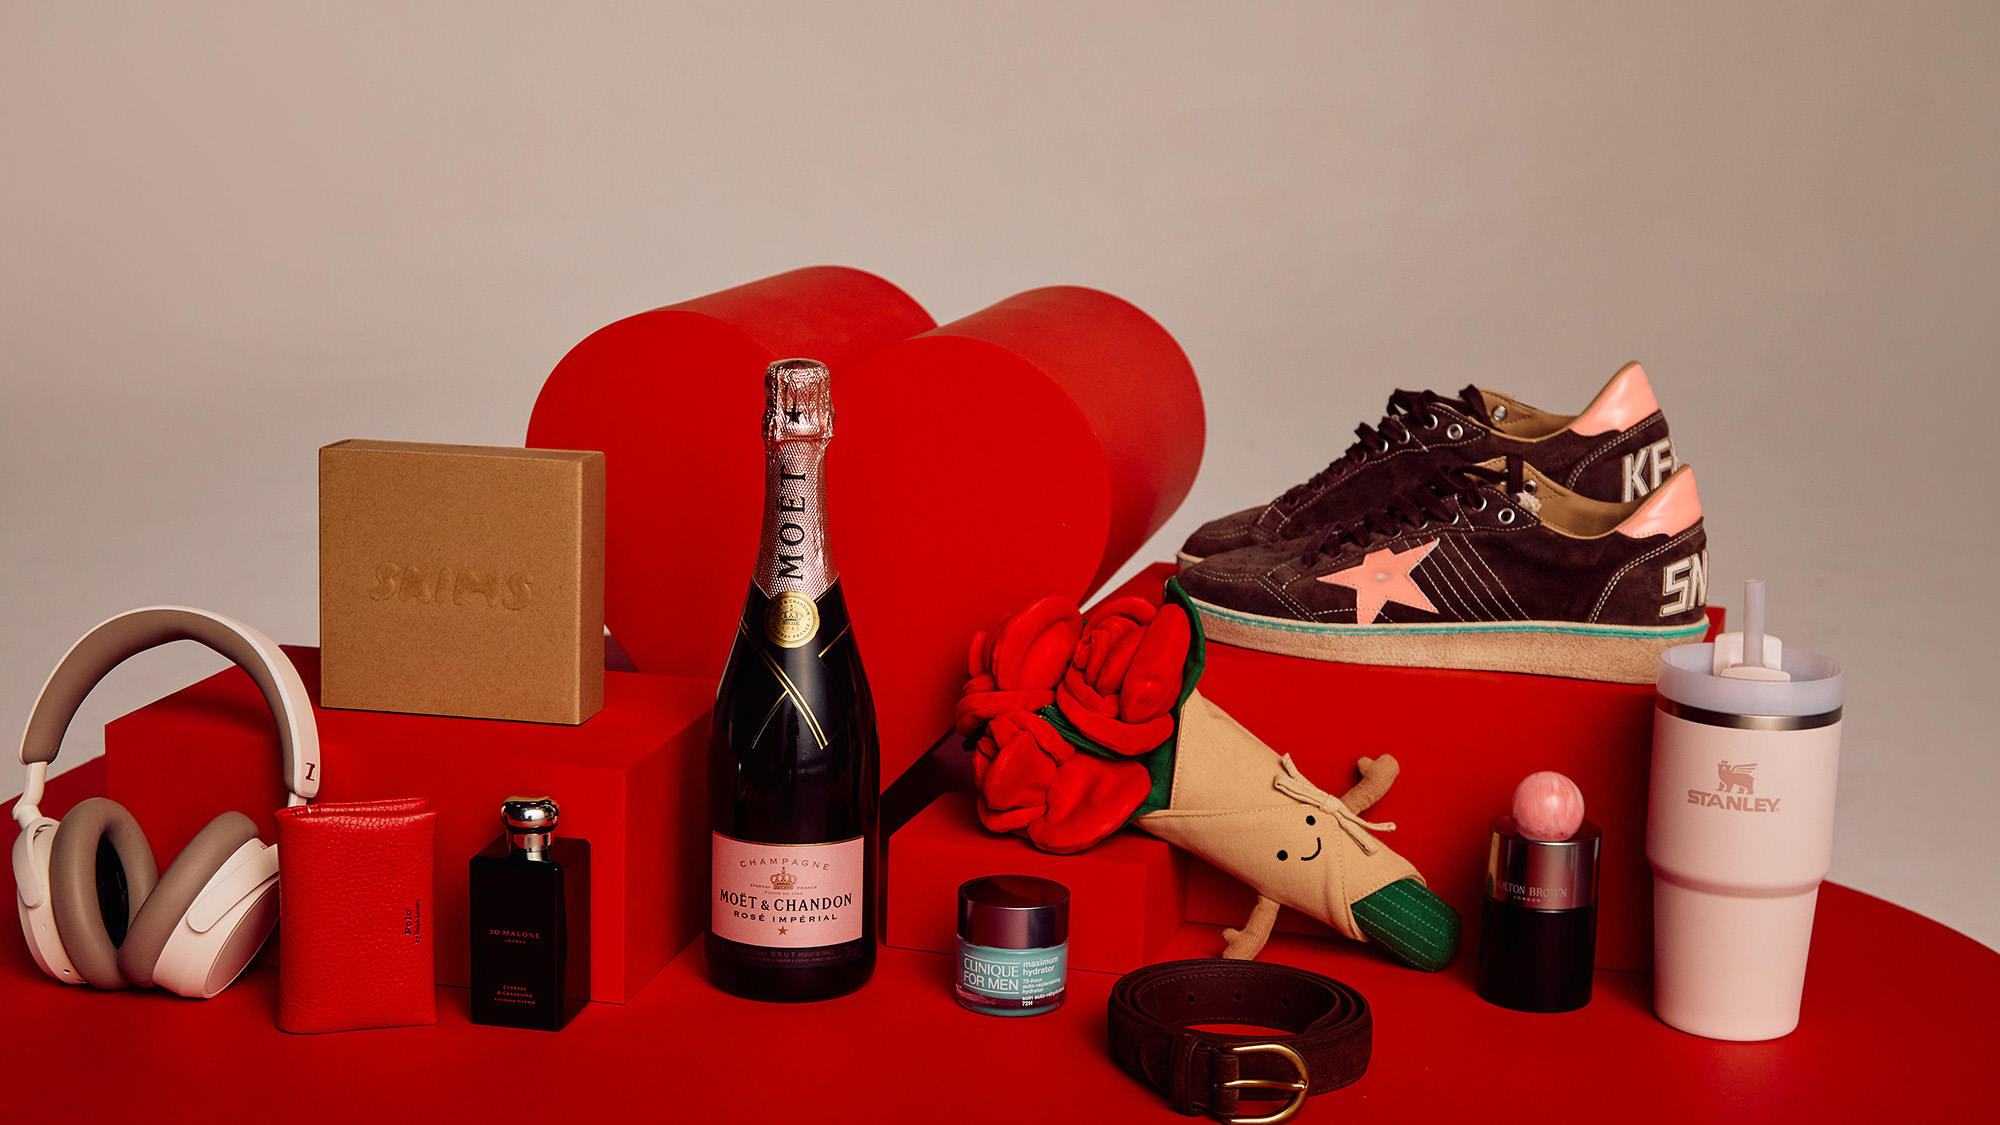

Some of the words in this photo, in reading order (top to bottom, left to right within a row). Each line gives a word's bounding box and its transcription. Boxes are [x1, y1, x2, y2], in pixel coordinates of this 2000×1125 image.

[368, 562, 534, 610] SKIMS
[1687, 789, 1781, 813] STANLEY
[740, 858, 830, 871] CHAMPAGNE
[1513, 895, 1541, 903] LONDON
[1529, 887, 1567, 898] BROWN
[720, 888, 758, 909] MOËT
[761, 900, 770, 911] &
[774, 893, 853, 912] CHANDON
[404, 909, 412, 936] Polo
[734, 911, 766, 922] ROSÉ
[772, 914, 838, 923] IMPÉRIAL
[502, 930, 541, 939] MALONE
[964, 957, 1019, 978] CLINIQUE
[1023, 956, 1059, 968] maximum
[1022, 965, 1055, 977] hydrator
[964, 971, 985, 987] FOR
[988, 977, 1019, 991] MEN
